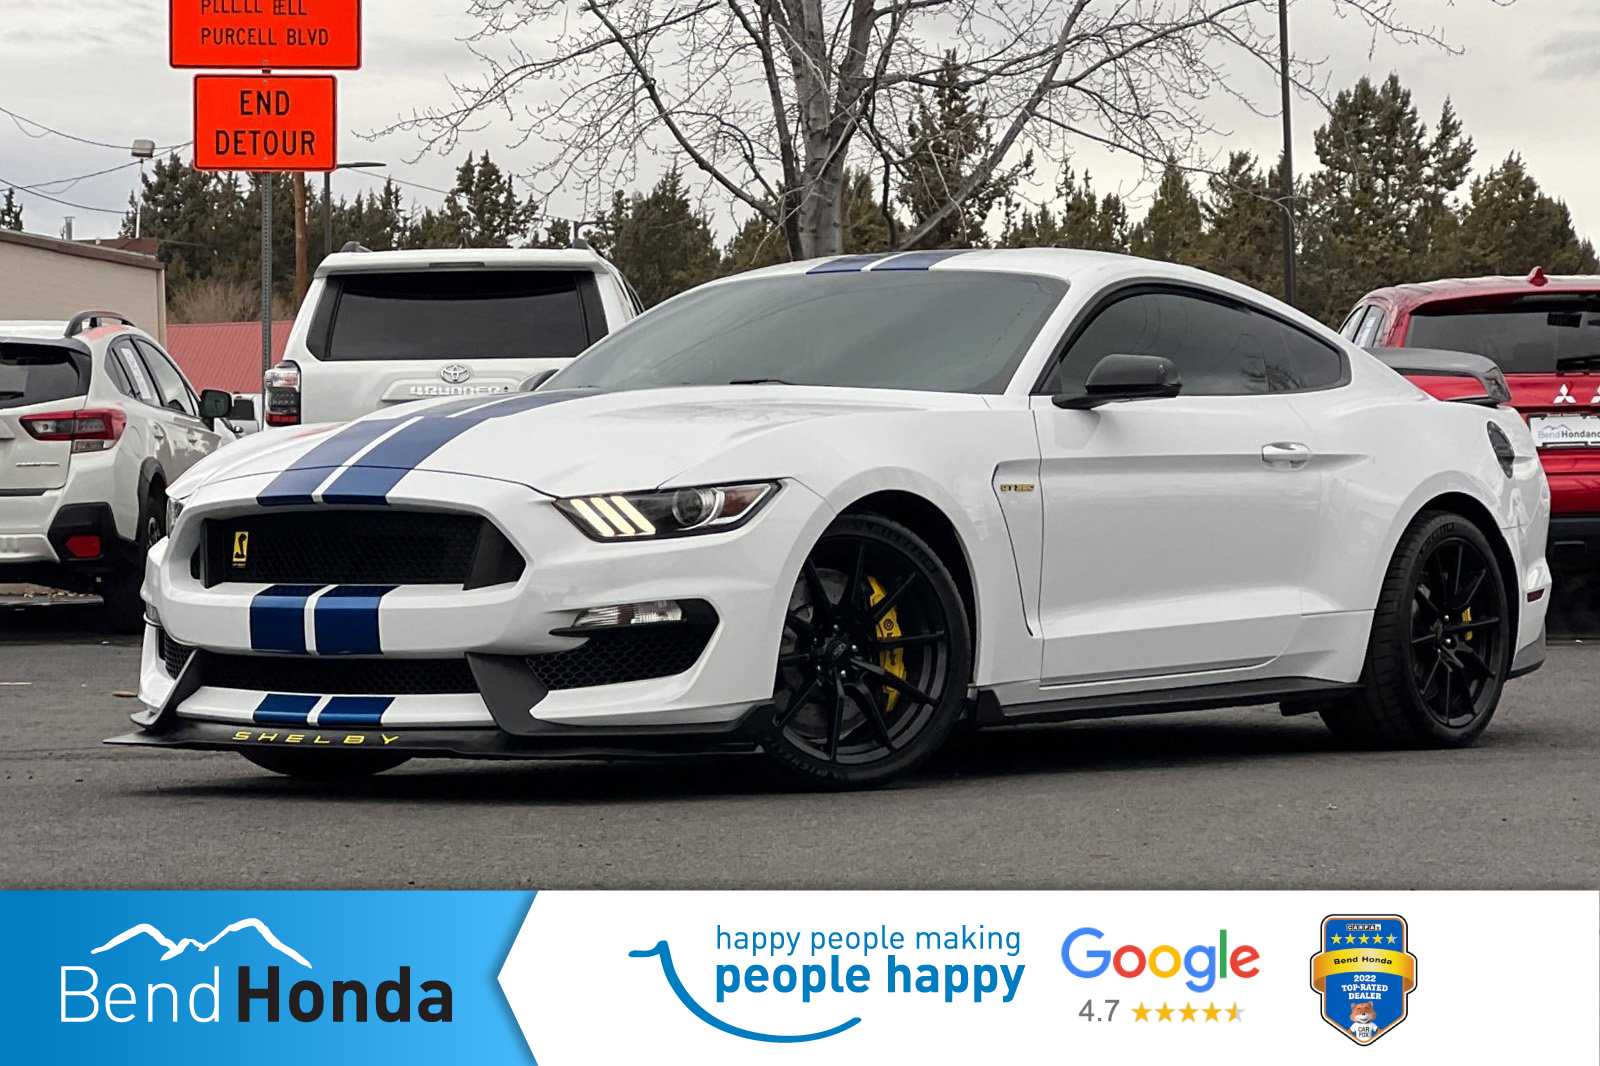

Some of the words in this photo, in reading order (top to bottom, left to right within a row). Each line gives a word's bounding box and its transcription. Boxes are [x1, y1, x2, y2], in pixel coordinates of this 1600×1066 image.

[201, 28, 277, 45] PURCELL
[286, 28, 329, 46] BLVD
[239, 90, 290, 116] END
[215, 130, 315, 155] DETOUR
[232, 731, 399, 745] SHELBY
